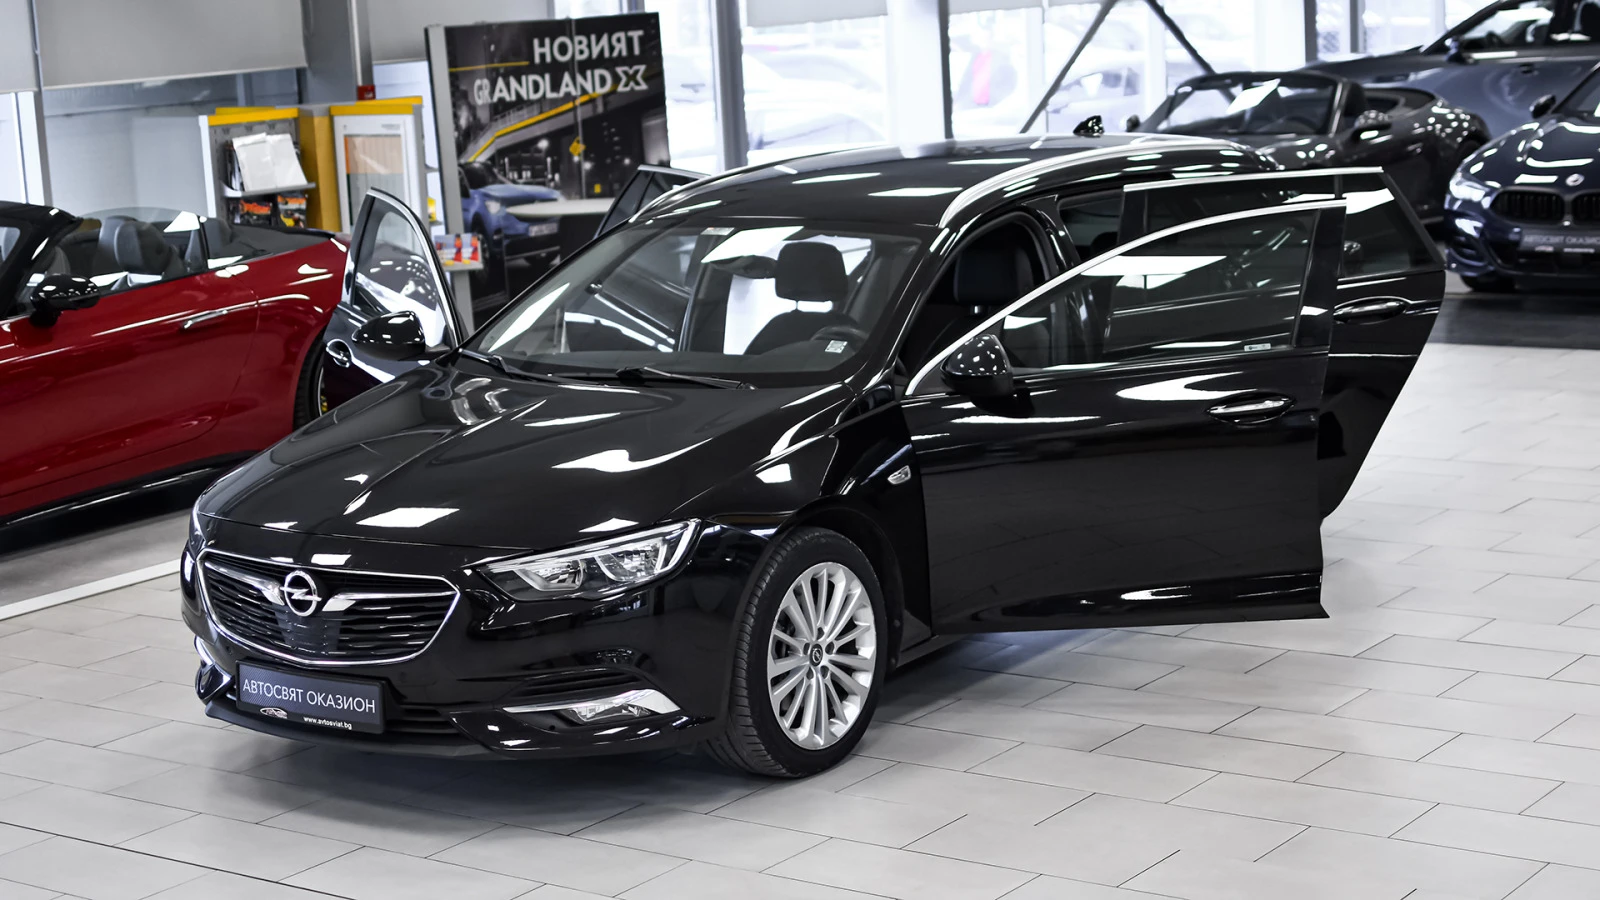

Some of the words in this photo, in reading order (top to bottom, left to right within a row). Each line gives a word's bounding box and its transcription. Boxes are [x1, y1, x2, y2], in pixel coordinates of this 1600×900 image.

[533, 30, 643, 64] НОВИЯТ
[473, 69, 613, 106] GRANDLAND
[243, 679, 303, 703] АВТОСВЯТ
[306, 690, 376, 714] ОКАЗИОН
[303, 716, 353, 730] www.avtosviat.bg
